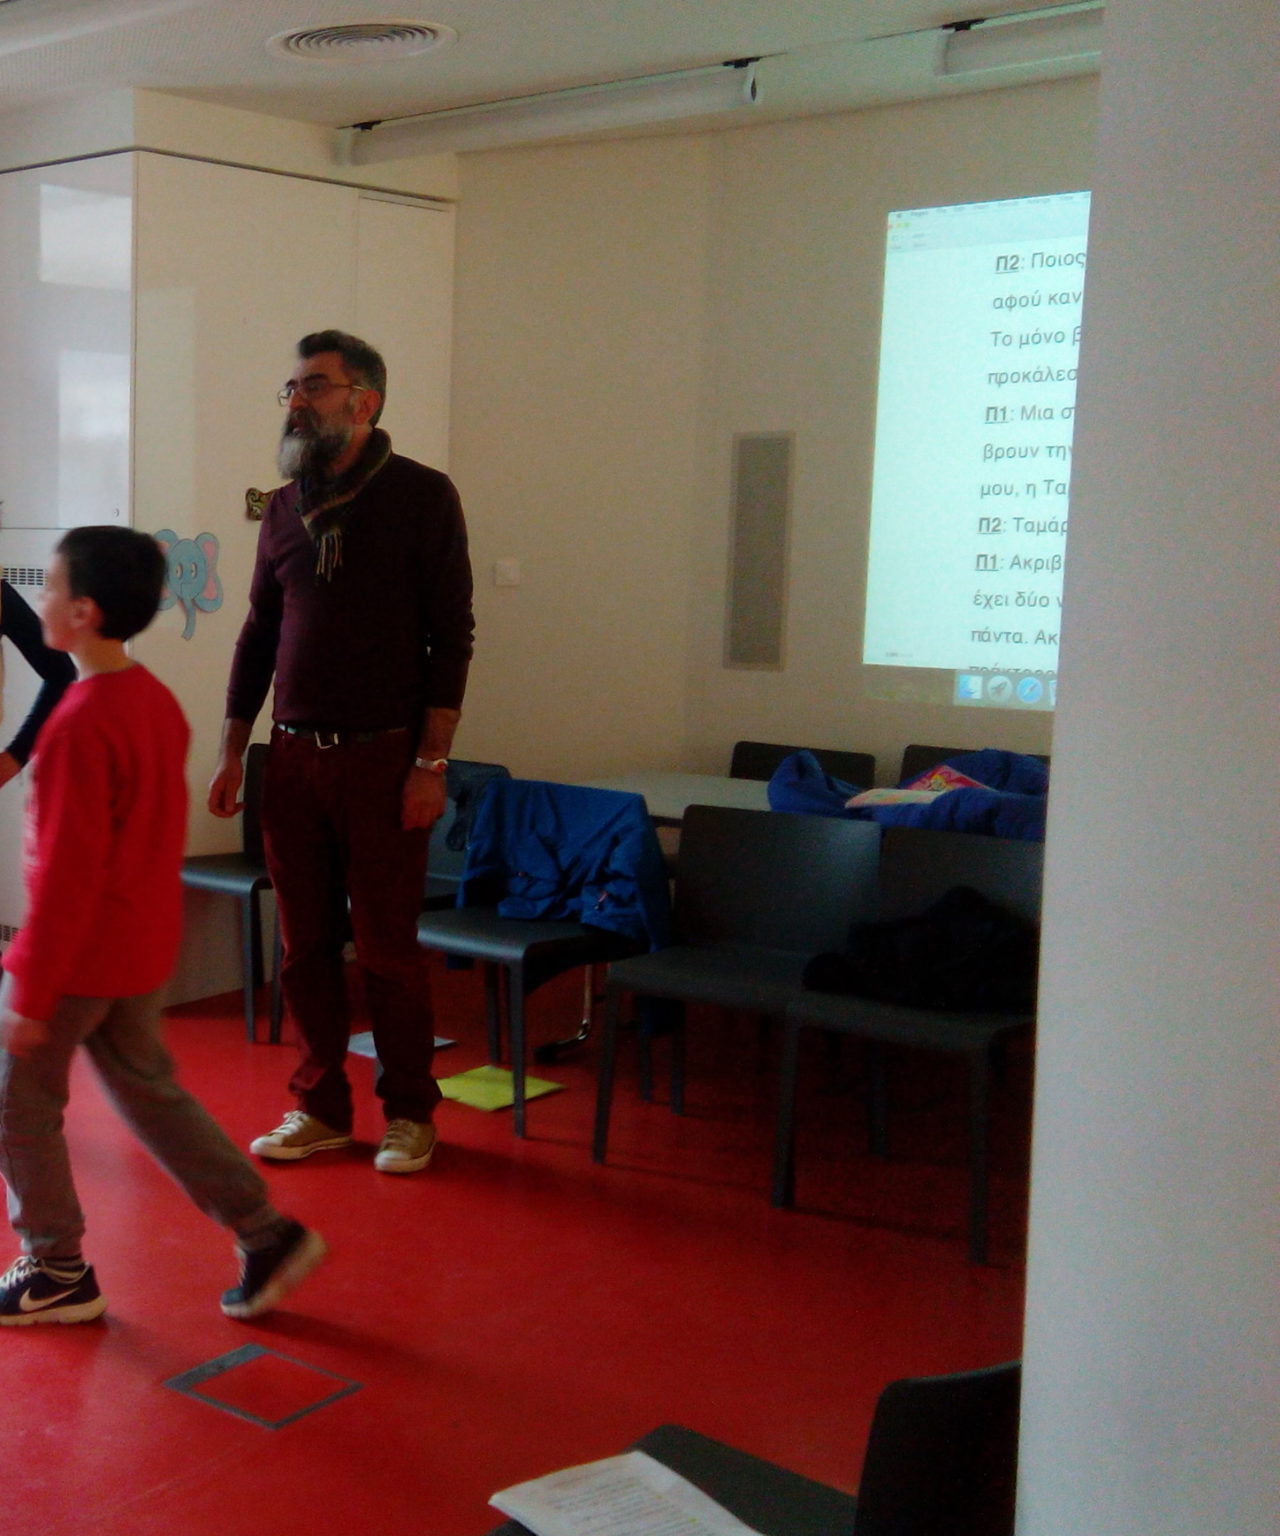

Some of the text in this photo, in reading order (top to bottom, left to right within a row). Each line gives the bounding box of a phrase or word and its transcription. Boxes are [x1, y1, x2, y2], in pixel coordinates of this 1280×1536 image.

[995, 252, 1086, 274] Π2: Ποιος
[992, 290, 1082, 309] αφού καν
[991, 331, 1013, 347] Το
[1019, 328, 1065, 349] μόνο
[985, 406, 1015, 424] Π1:
[1020, 404, 1054, 420] Μια
[983, 443, 1039, 463] βρουν
[980, 479, 1067, 499] μου, η Τα
[977, 517, 1007, 534] Π2:
[975, 553, 1062, 574] Π1: Ακριβ
[973, 589, 1009, 610] έχει
[1015, 590, 1050, 608] δύο
[970, 626, 1058, 645] πάντα. Ακ
